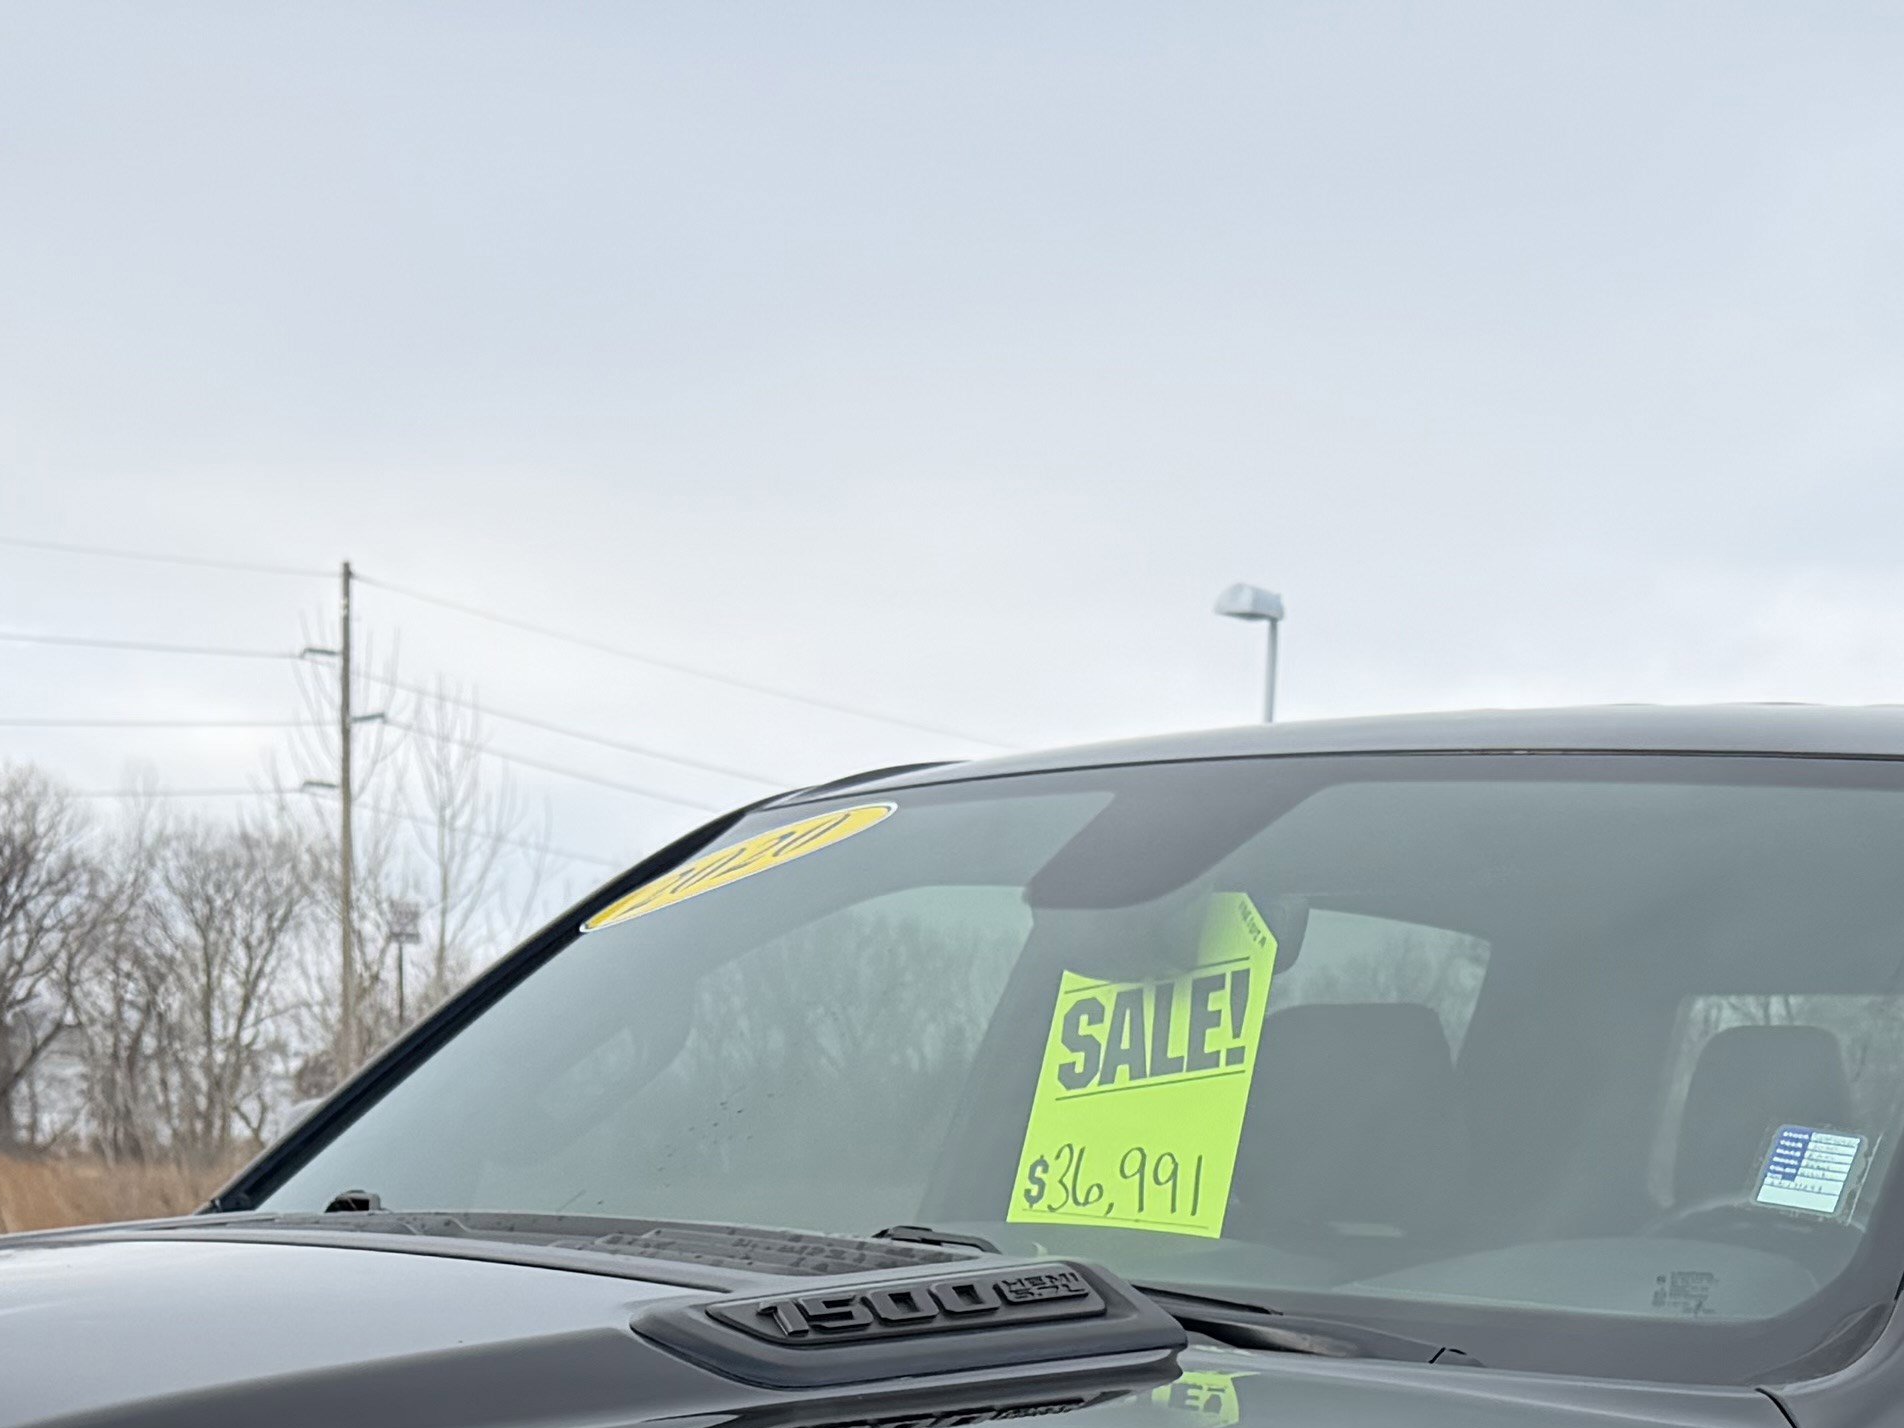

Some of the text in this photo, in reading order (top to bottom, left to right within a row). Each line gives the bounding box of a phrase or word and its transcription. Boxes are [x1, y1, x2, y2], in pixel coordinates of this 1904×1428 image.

[1057, 968, 1251, 1091] SALE!
[1023, 1143, 1203, 1217] $36,991
[756, 1283, 1001, 1337] 1500
